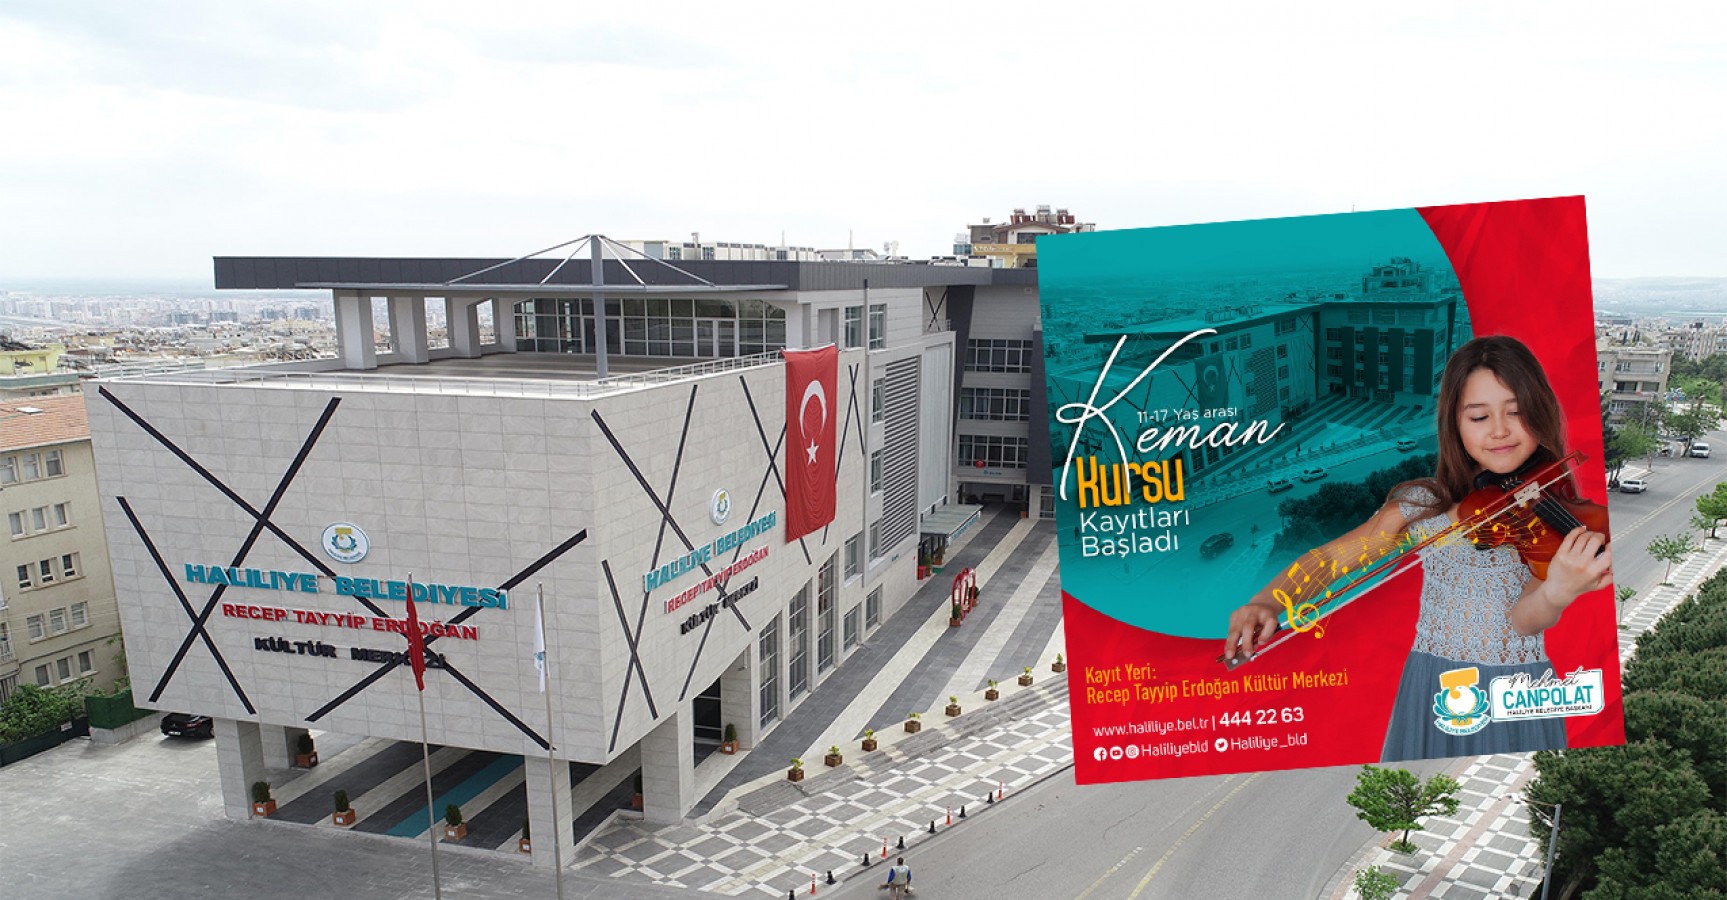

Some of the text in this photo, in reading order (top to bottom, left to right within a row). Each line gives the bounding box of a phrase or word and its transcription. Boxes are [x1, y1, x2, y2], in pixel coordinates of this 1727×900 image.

[667, 585, 699, 613] RECEP
[222, 603, 287, 621] RECEP
[292, 610, 366, 630] TAYYİP
[254, 636, 337, 658] KÜLTÜR
